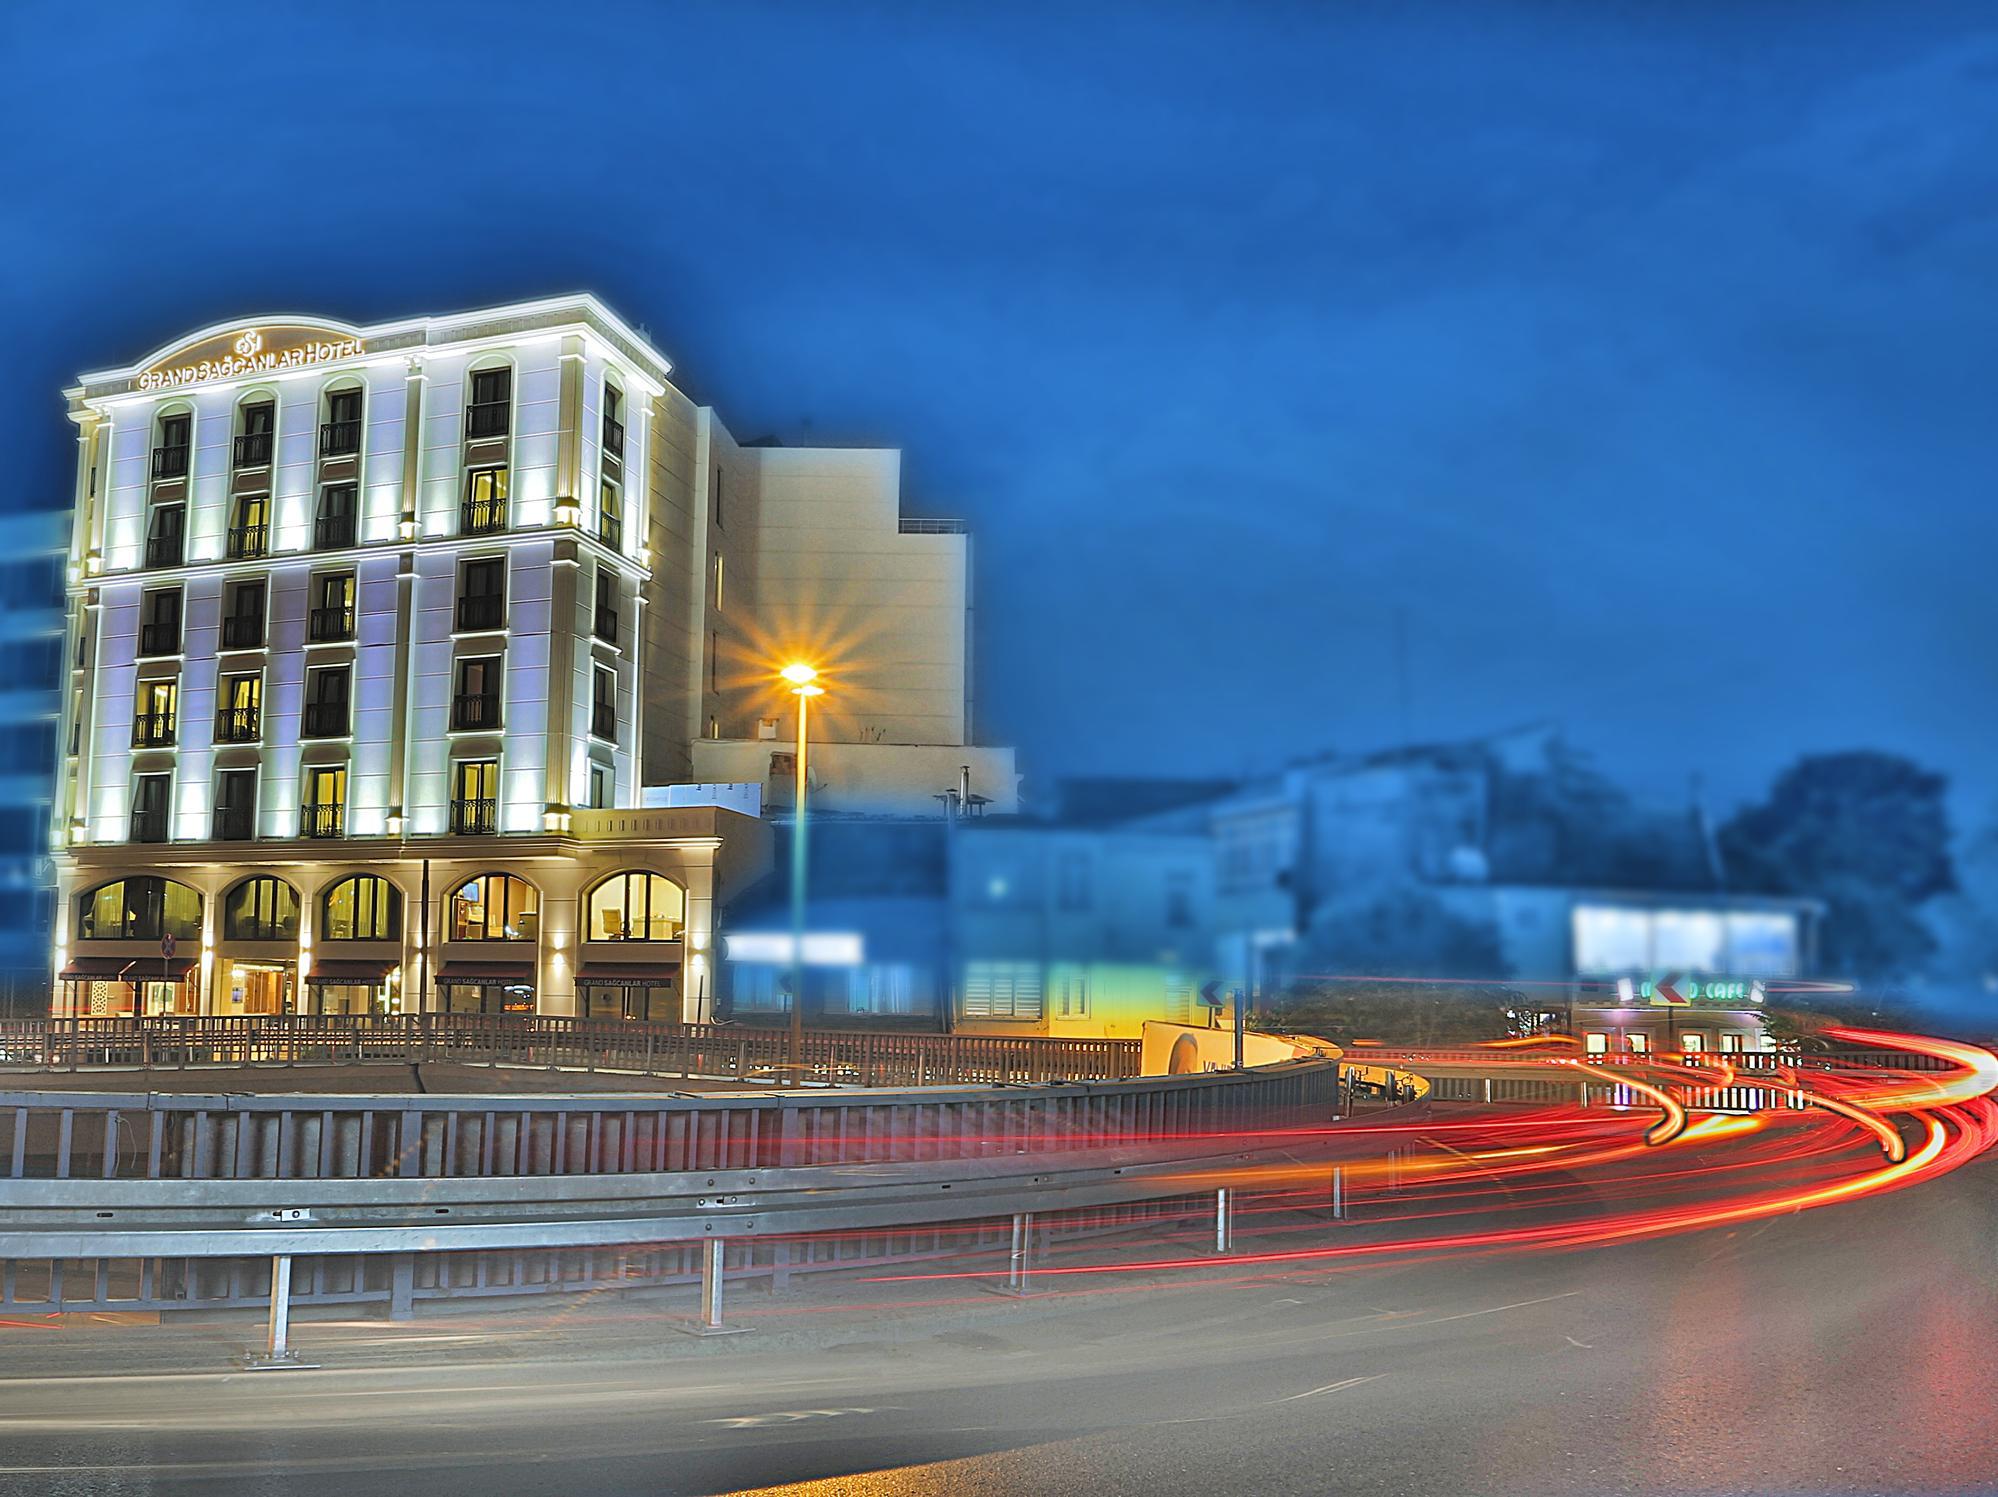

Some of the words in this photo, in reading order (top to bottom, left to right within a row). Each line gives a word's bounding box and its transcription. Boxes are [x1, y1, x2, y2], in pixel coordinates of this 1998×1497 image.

[138, 366, 197, 390] GRAND
[304, 340, 365, 364] HOTEL
[1705, 981, 1744, 999] CAFE
